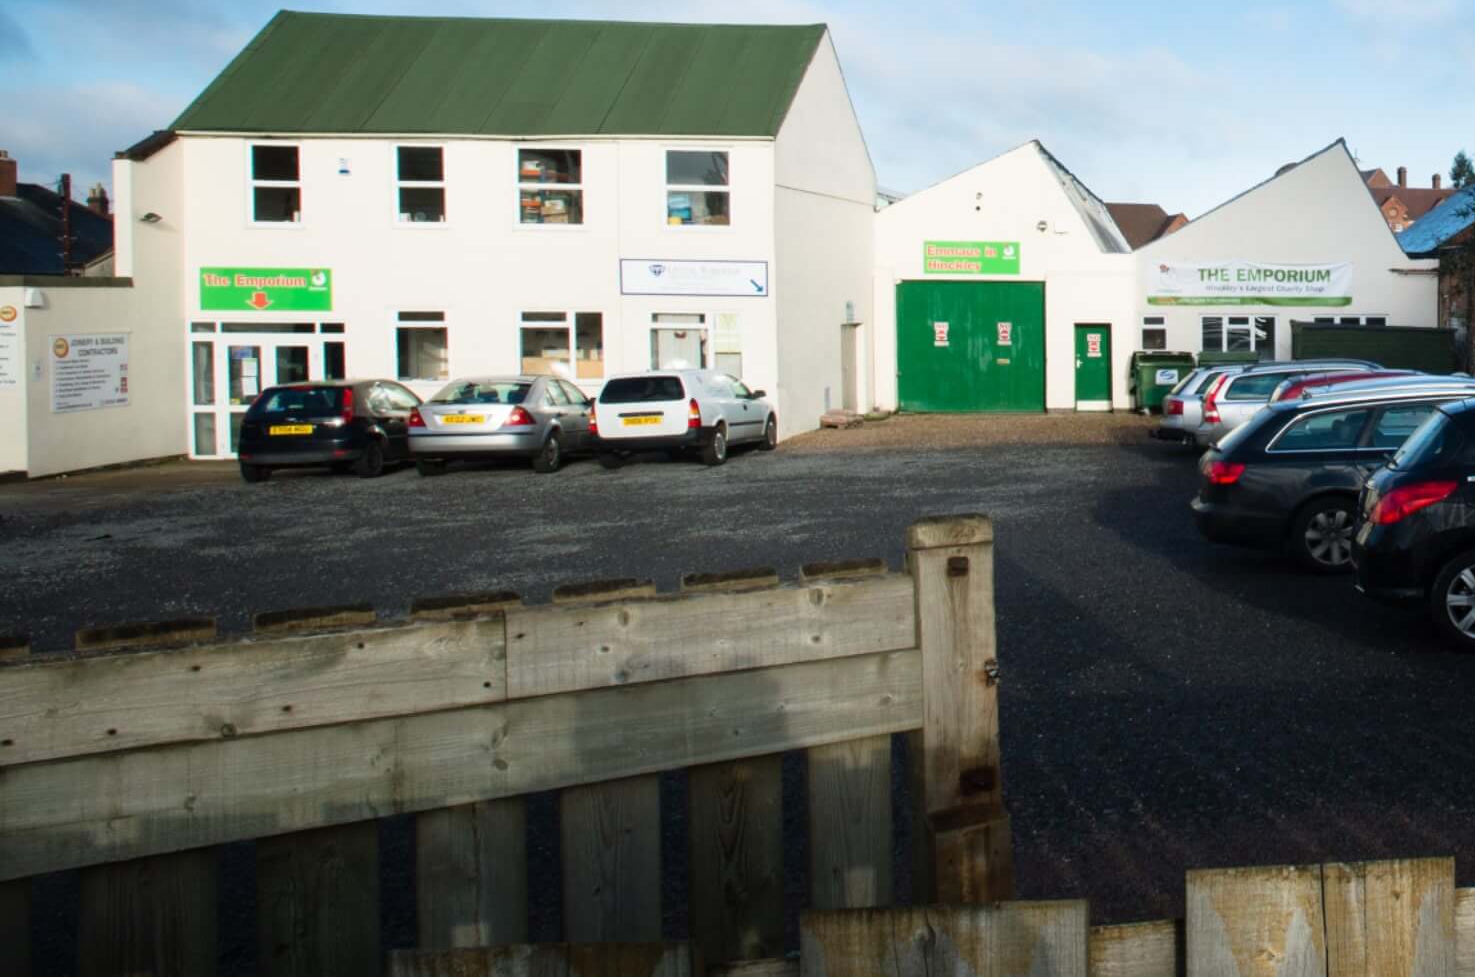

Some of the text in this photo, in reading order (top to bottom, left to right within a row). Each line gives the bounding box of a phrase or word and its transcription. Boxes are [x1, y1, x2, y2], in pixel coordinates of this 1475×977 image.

[928, 245, 980, 257] Emmaus
[928, 259, 980, 271] Hinckley
[204, 273, 306, 290] The Emporium
[1198, 268, 1331, 283] THE EMPORIUM
